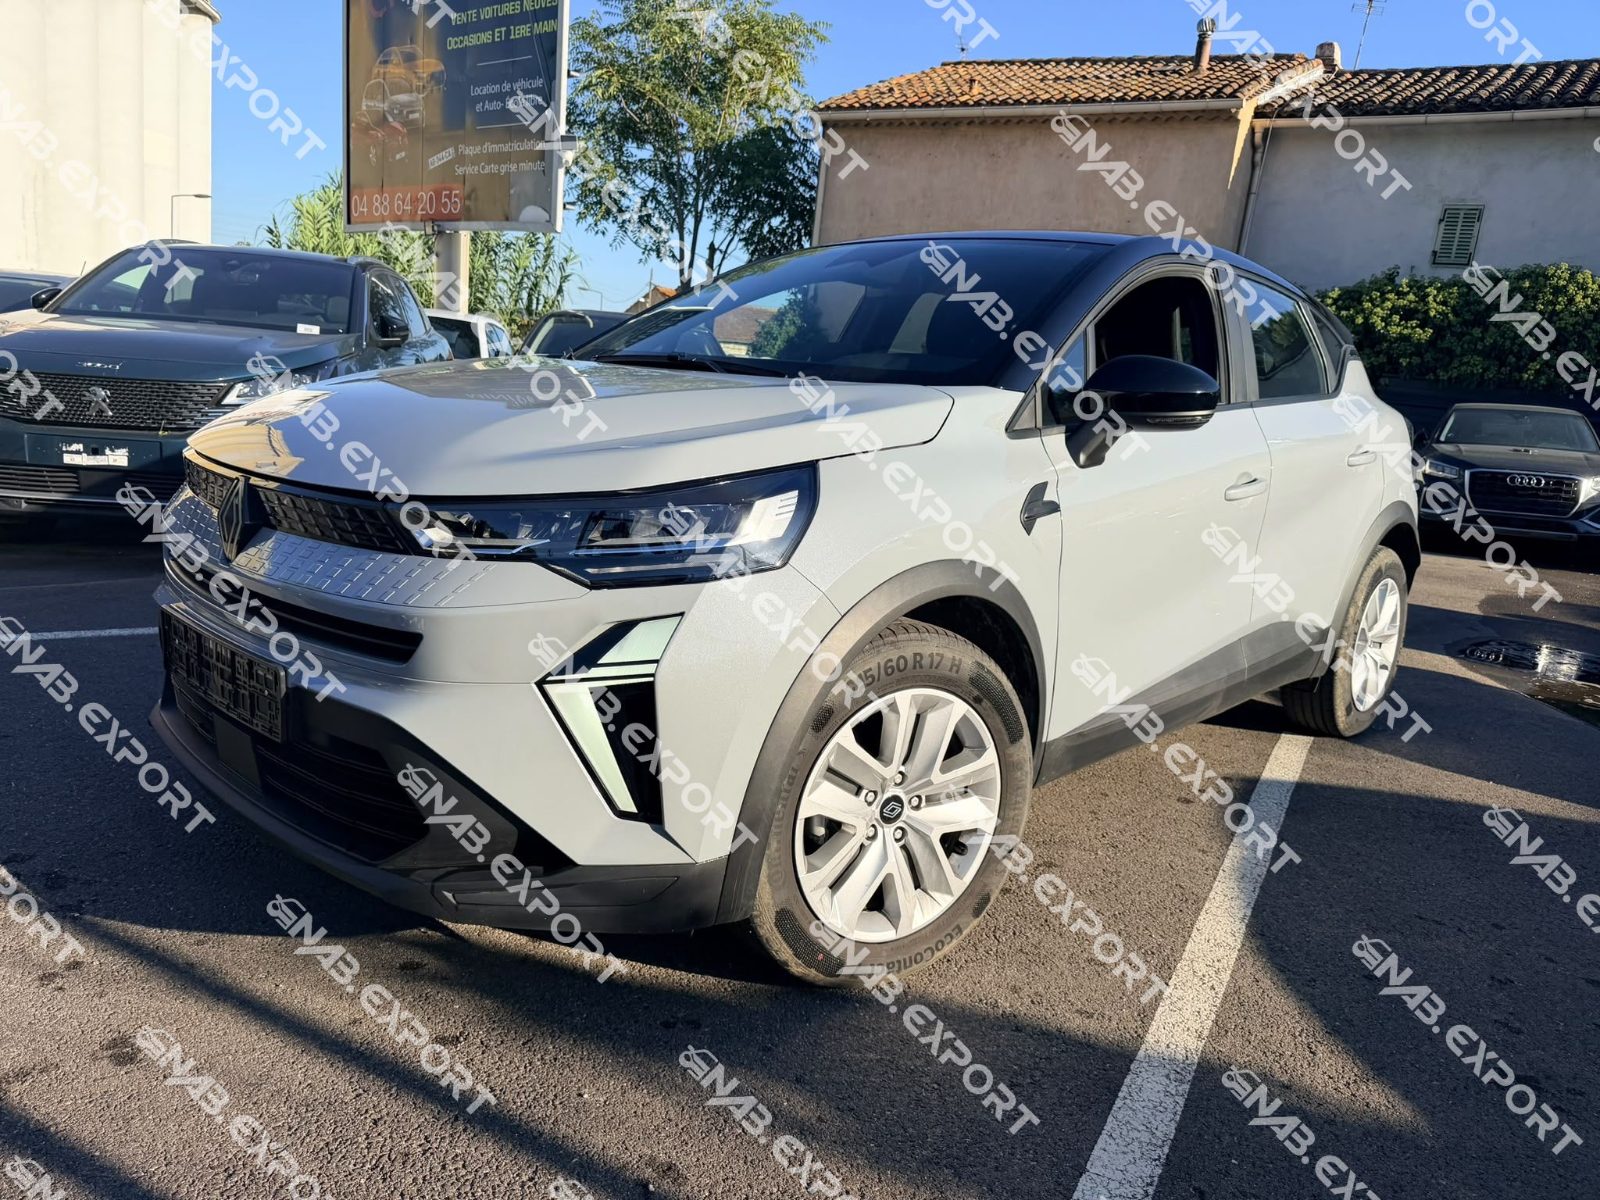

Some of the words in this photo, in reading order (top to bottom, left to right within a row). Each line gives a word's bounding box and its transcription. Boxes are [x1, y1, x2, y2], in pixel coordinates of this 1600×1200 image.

[451, 9, 477, 25] VENTE
[480, 1, 521, 20] VOITURES
[447, 31, 492, 50] OCCASIONS
[494, 27, 507, 42] ET
[509, 24, 532, 40] 1ERE
[533, 19, 560, 35] MAIN
[470, 82, 500, 97] Location
[501, 80, 511, 93] de
[512, 76, 544, 92] véhicule
[475, 100, 483, 112] et
[458, 143, 481, 157] Plaque
[482, 138, 545, 154] d'immatriculation
[454, 163, 479, 176] Service
[480, 161, 498, 174] Carte
[499, 161, 518, 176] grise
[518, 160, 546, 171] minute
[352, 193, 368, 216] 04
[373, 193, 390, 216] 88
[394, 192, 413, 215] 64
[417, 191, 436, 215] 20
[441, 190, 461, 214] 55
[912, 652, 924, 670] R
[927, 652, 945, 670] 17
[948, 655, 963, 674] H
